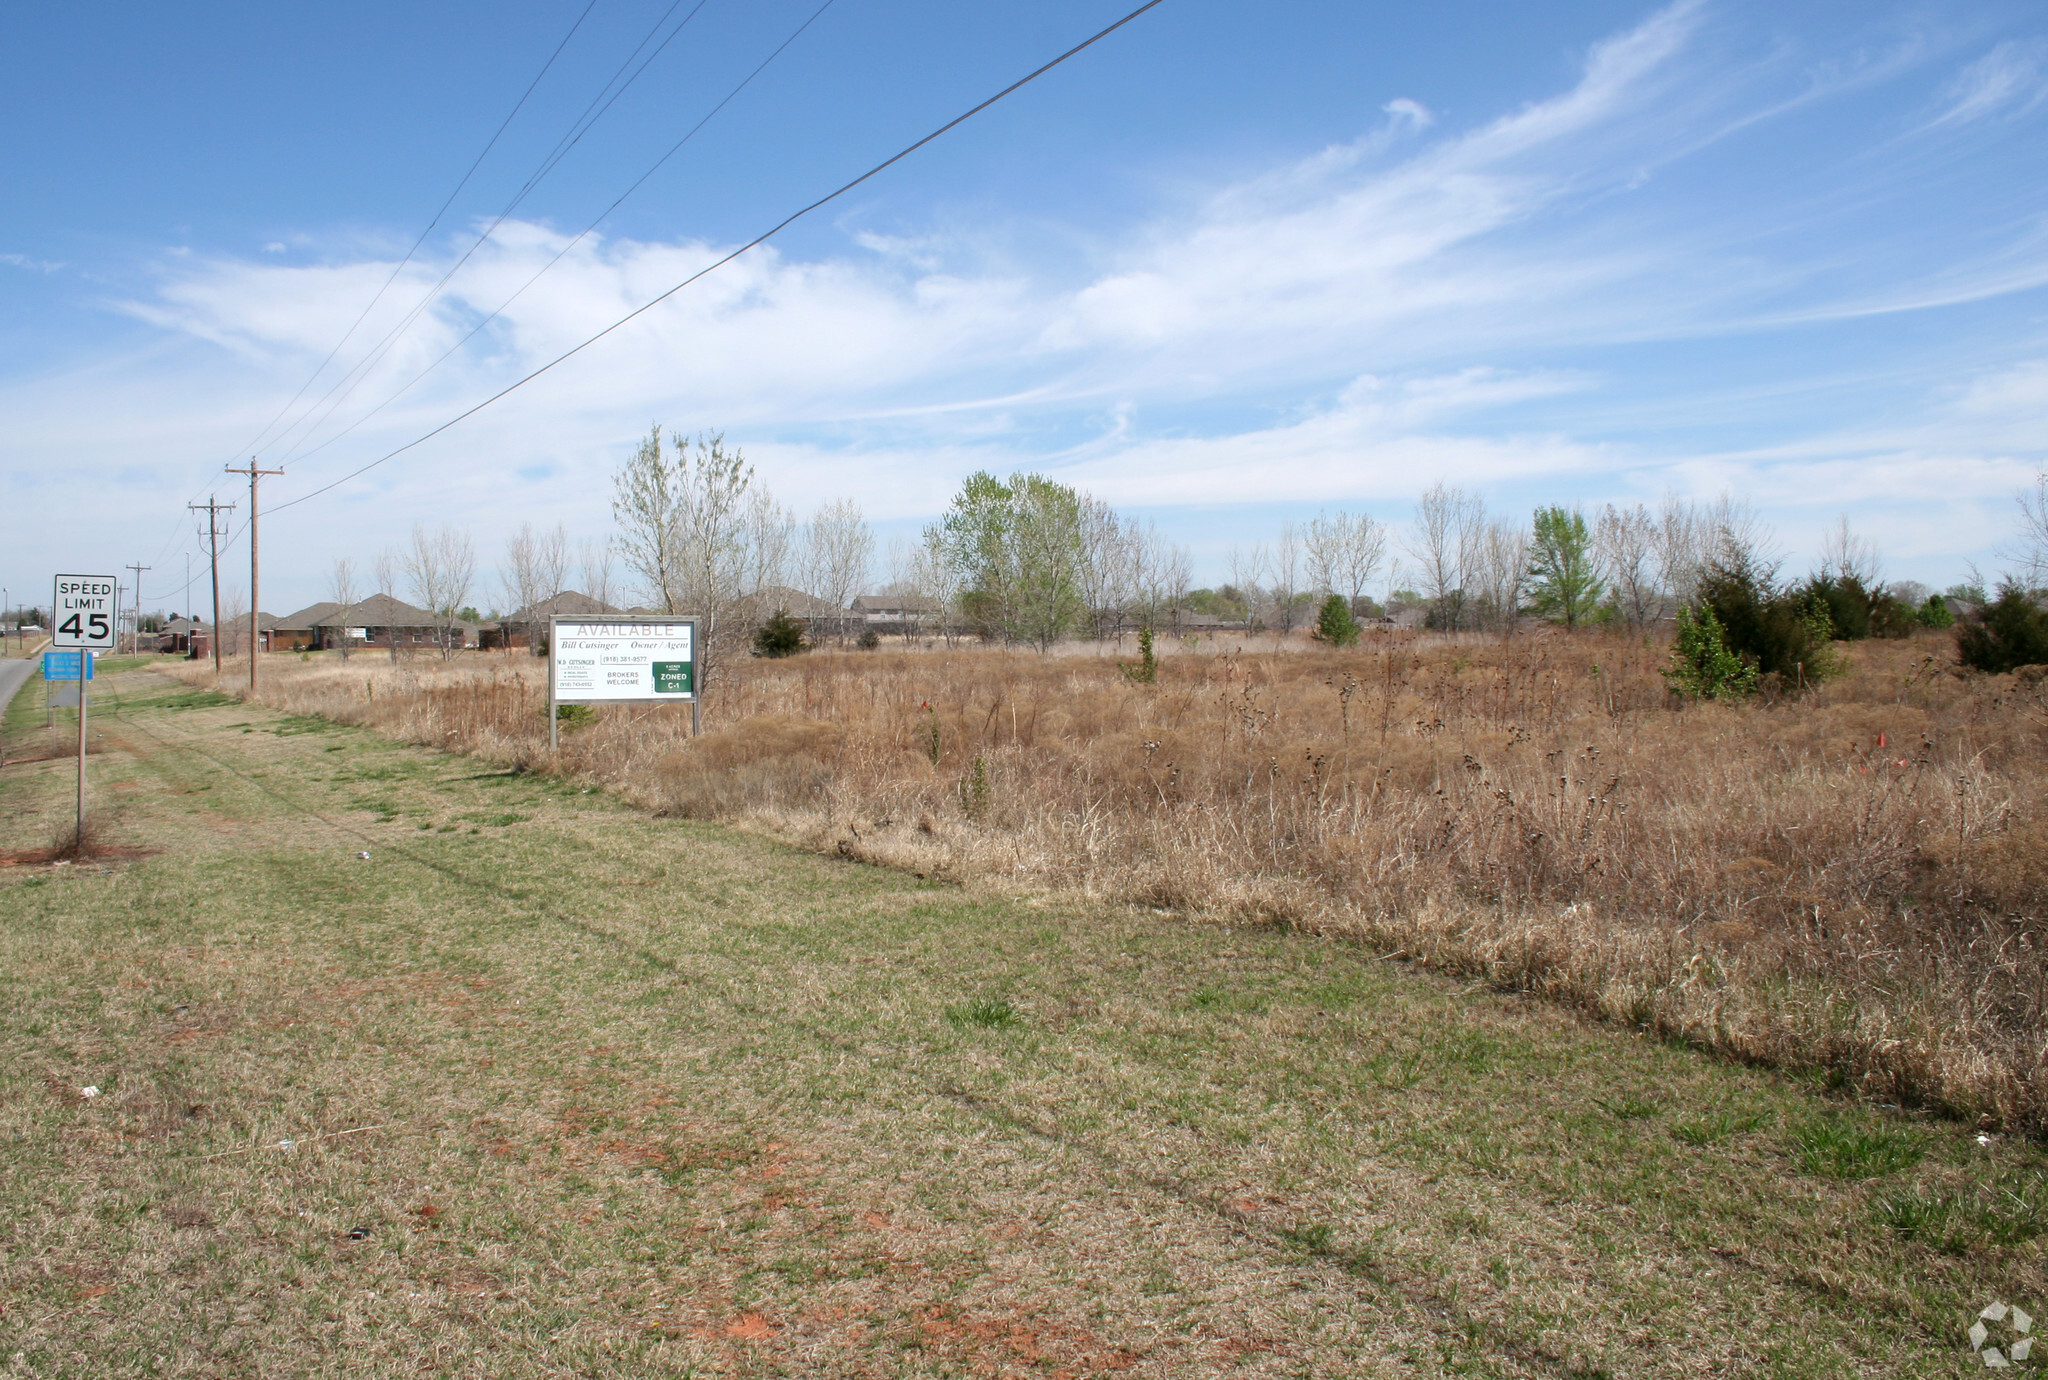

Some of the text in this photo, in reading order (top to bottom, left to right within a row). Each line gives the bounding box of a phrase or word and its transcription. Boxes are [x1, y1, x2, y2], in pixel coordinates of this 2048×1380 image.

[60, 583, 111, 595] SPEED
[65, 598, 105, 609] LIMIT
[58, 613, 110, 640] 45
[577, 624, 674, 636] AVAILABLE
[561, 641, 619, 651] Bill Cutsinger
[630, 641, 658, 649] Owner
[664, 641, 689, 650] Agent
